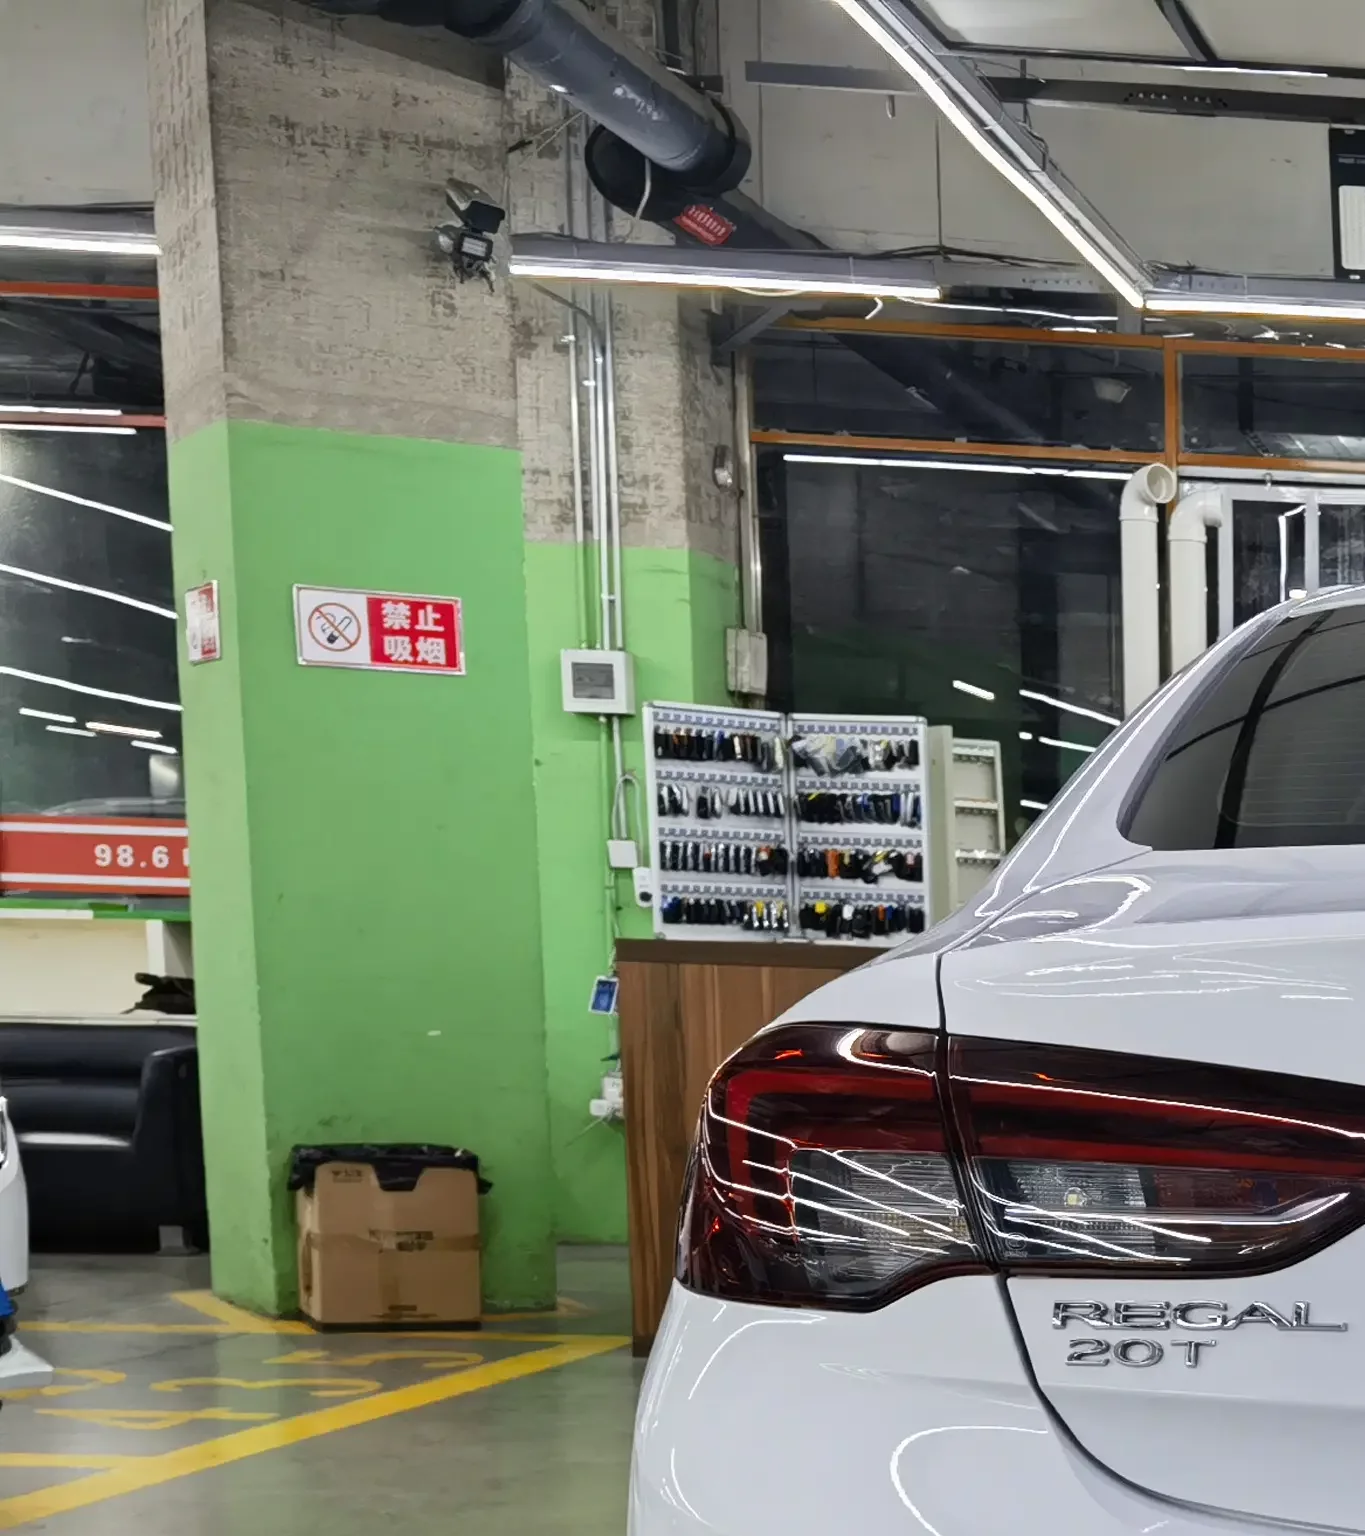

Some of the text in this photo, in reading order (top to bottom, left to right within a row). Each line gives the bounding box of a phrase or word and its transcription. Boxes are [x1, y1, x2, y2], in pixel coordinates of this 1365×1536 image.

[381, 600, 445, 632] 禁止
[382, 634, 447, 665] 吸烟
[94, 844, 169, 868] 98.6
[1052, 1300, 1348, 1332] REGAL
[1065, 1338, 1217, 1368] 20T
